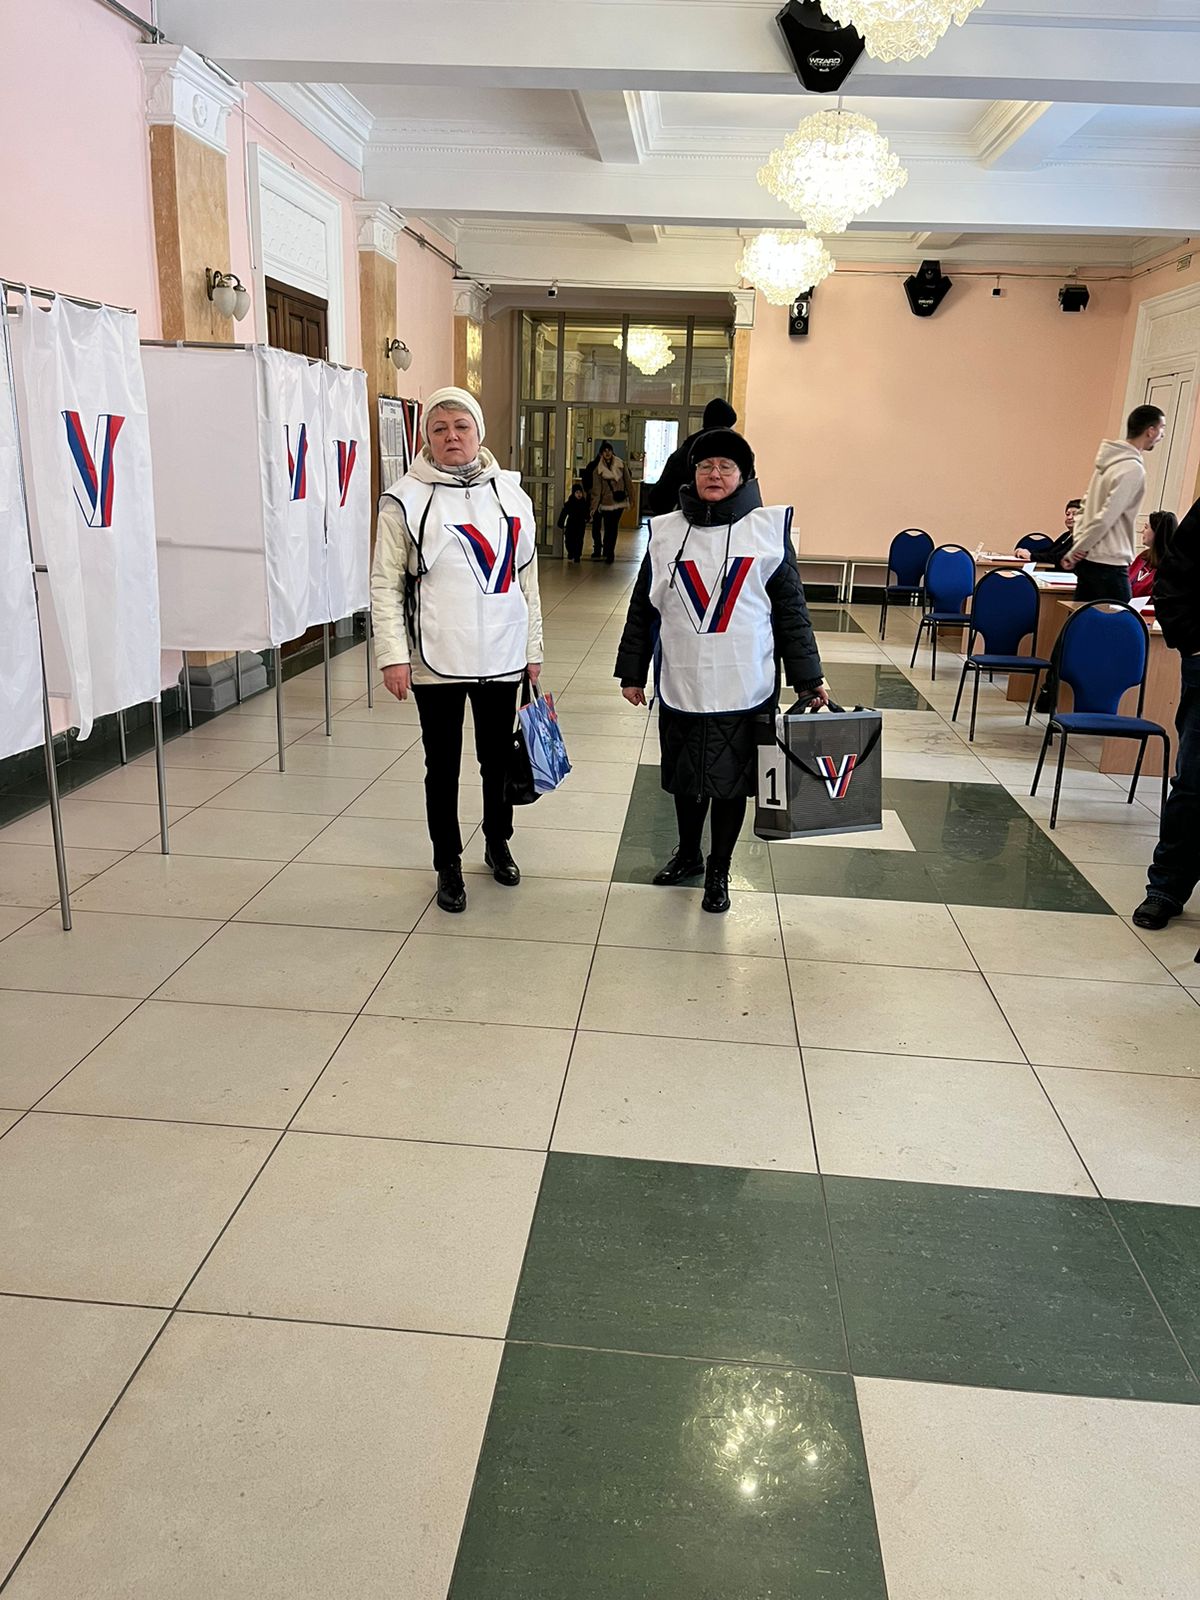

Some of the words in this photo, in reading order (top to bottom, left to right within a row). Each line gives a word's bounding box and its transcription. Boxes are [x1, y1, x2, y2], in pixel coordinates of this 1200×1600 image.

[61, 410, 126, 527] V
[444, 516, 521, 594] V
[667, 556, 755, 634] V
[766, 767, 781, 806] 1
[816, 753, 858, 800] V
